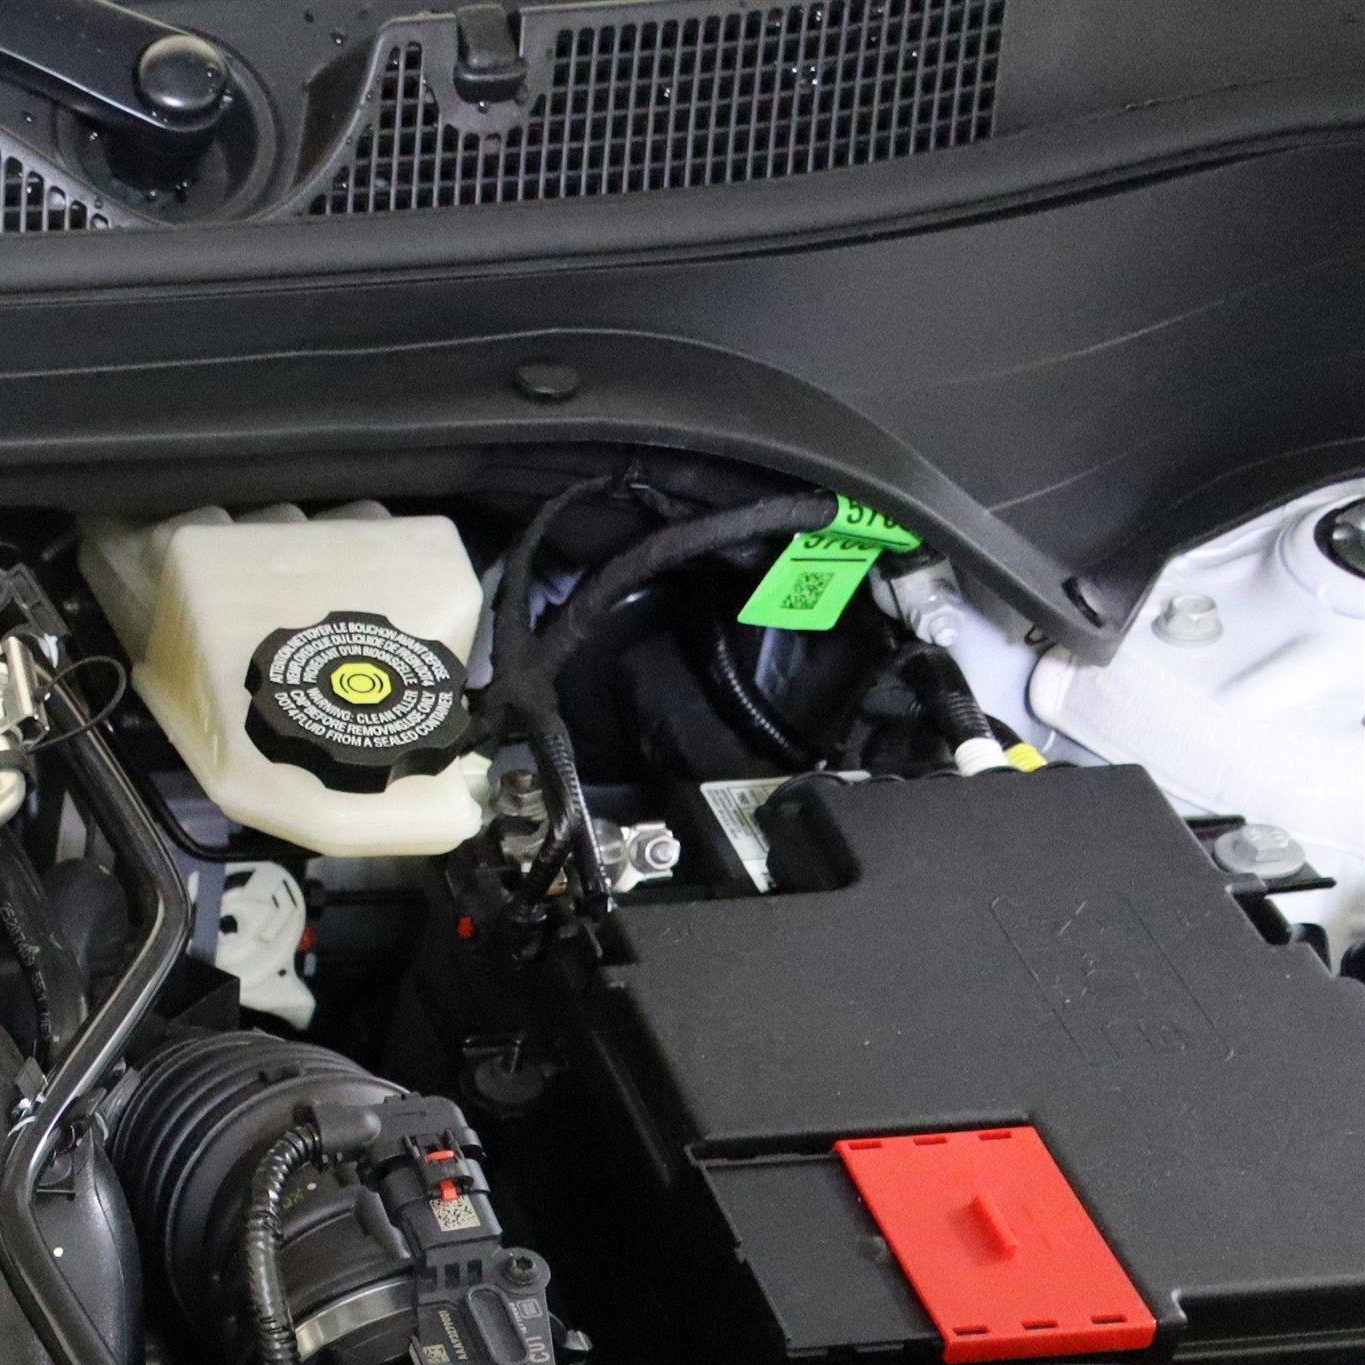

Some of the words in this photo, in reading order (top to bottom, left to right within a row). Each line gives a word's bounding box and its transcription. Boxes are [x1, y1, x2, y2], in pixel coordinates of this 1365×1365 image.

[331, 634, 347, 646] DU
[346, 634, 386, 649] LIQUIDE
[384, 640, 401, 654] DE
[333, 622, 348, 634] LE
[348, 622, 398, 641] BOUCHON
[338, 645, 362, 657] D'UN
[274, 692, 297, 711] DOT
[292, 713, 326, 736] FLUID
[325, 729, 362, 747] FROM
[363, 736, 373, 748] A
[373, 730, 419, 748] SEALED
[290, 690, 312, 708] CAP
[303, 704, 347, 733] BEFORE
[417, 690, 436, 714] ONLY
[356, 710, 397, 725] CLEAN
[392, 690, 419, 717] FILLER
